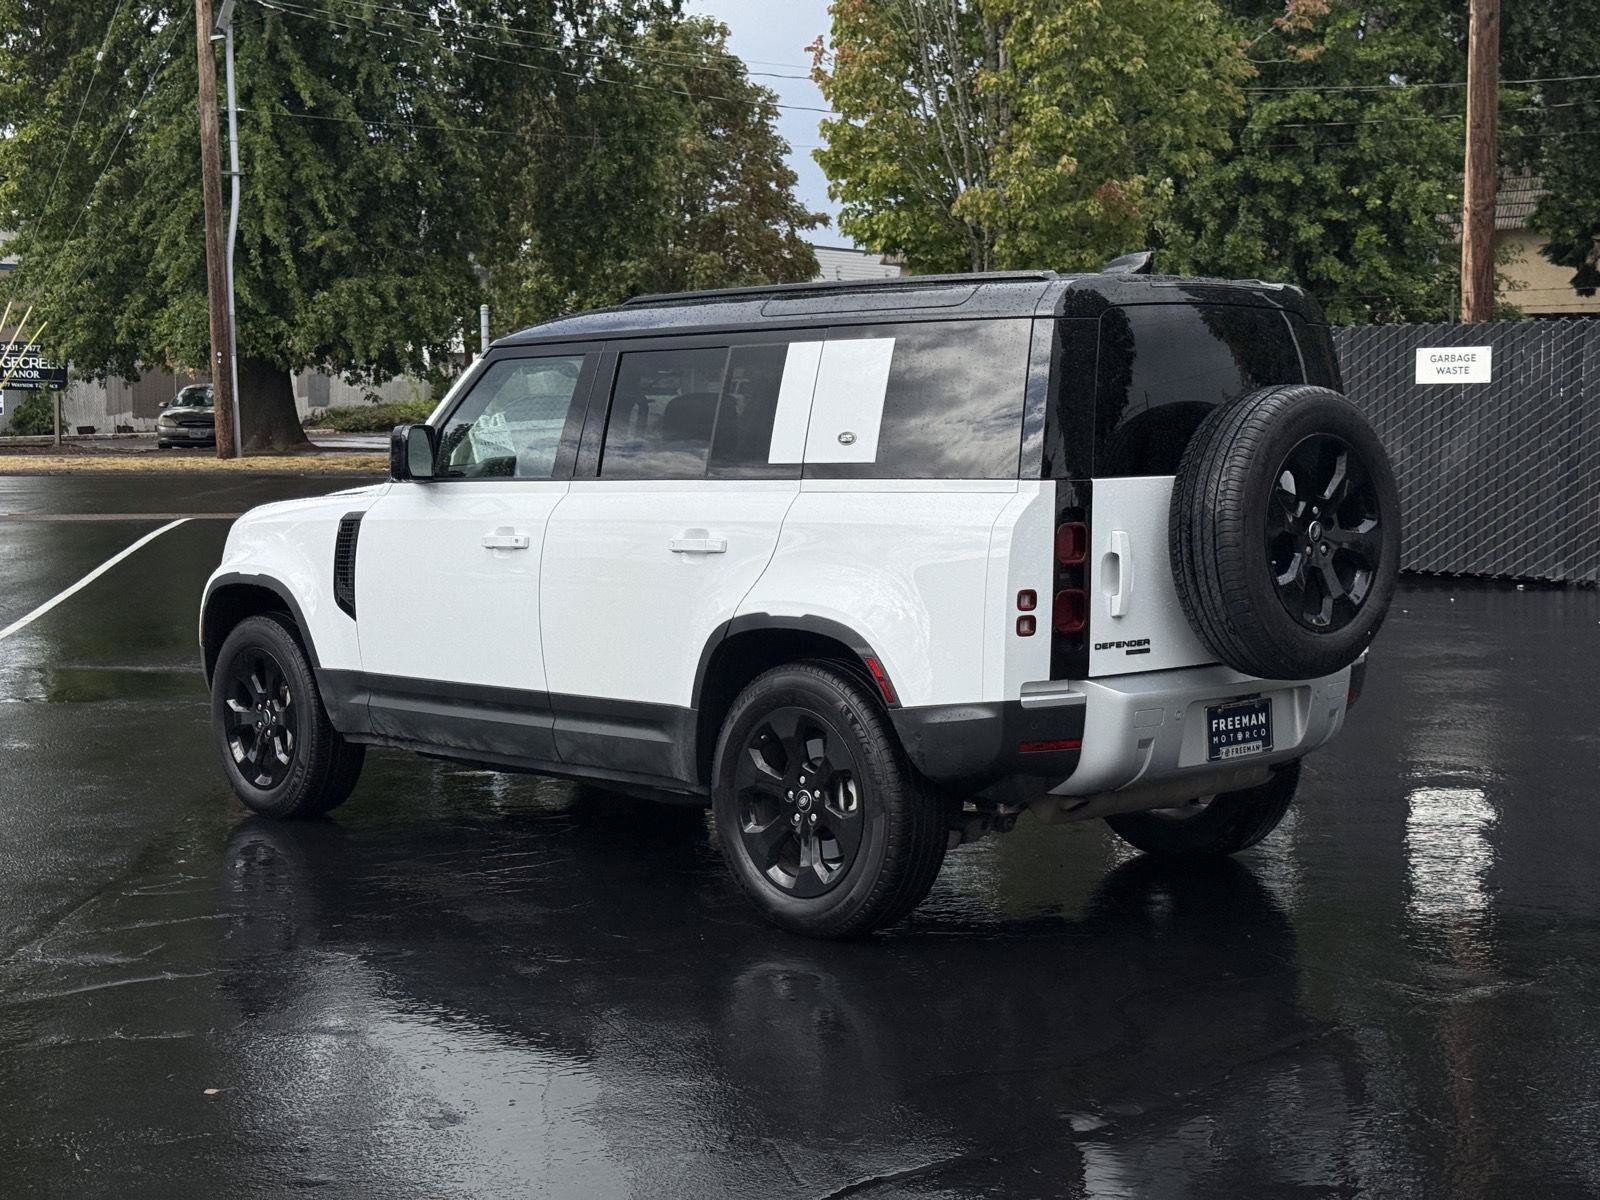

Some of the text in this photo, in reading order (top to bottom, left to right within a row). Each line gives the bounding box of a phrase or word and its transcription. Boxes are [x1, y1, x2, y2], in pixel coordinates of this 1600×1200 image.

[1429, 353, 1477, 363] GARBAGE
[3, 369, 40, 379] MANOR
[1436, 366, 1470, 375] WASTE
[1094, 638, 1151, 651] DEFENDER
[1212, 712, 1266, 732] FREEMAN
